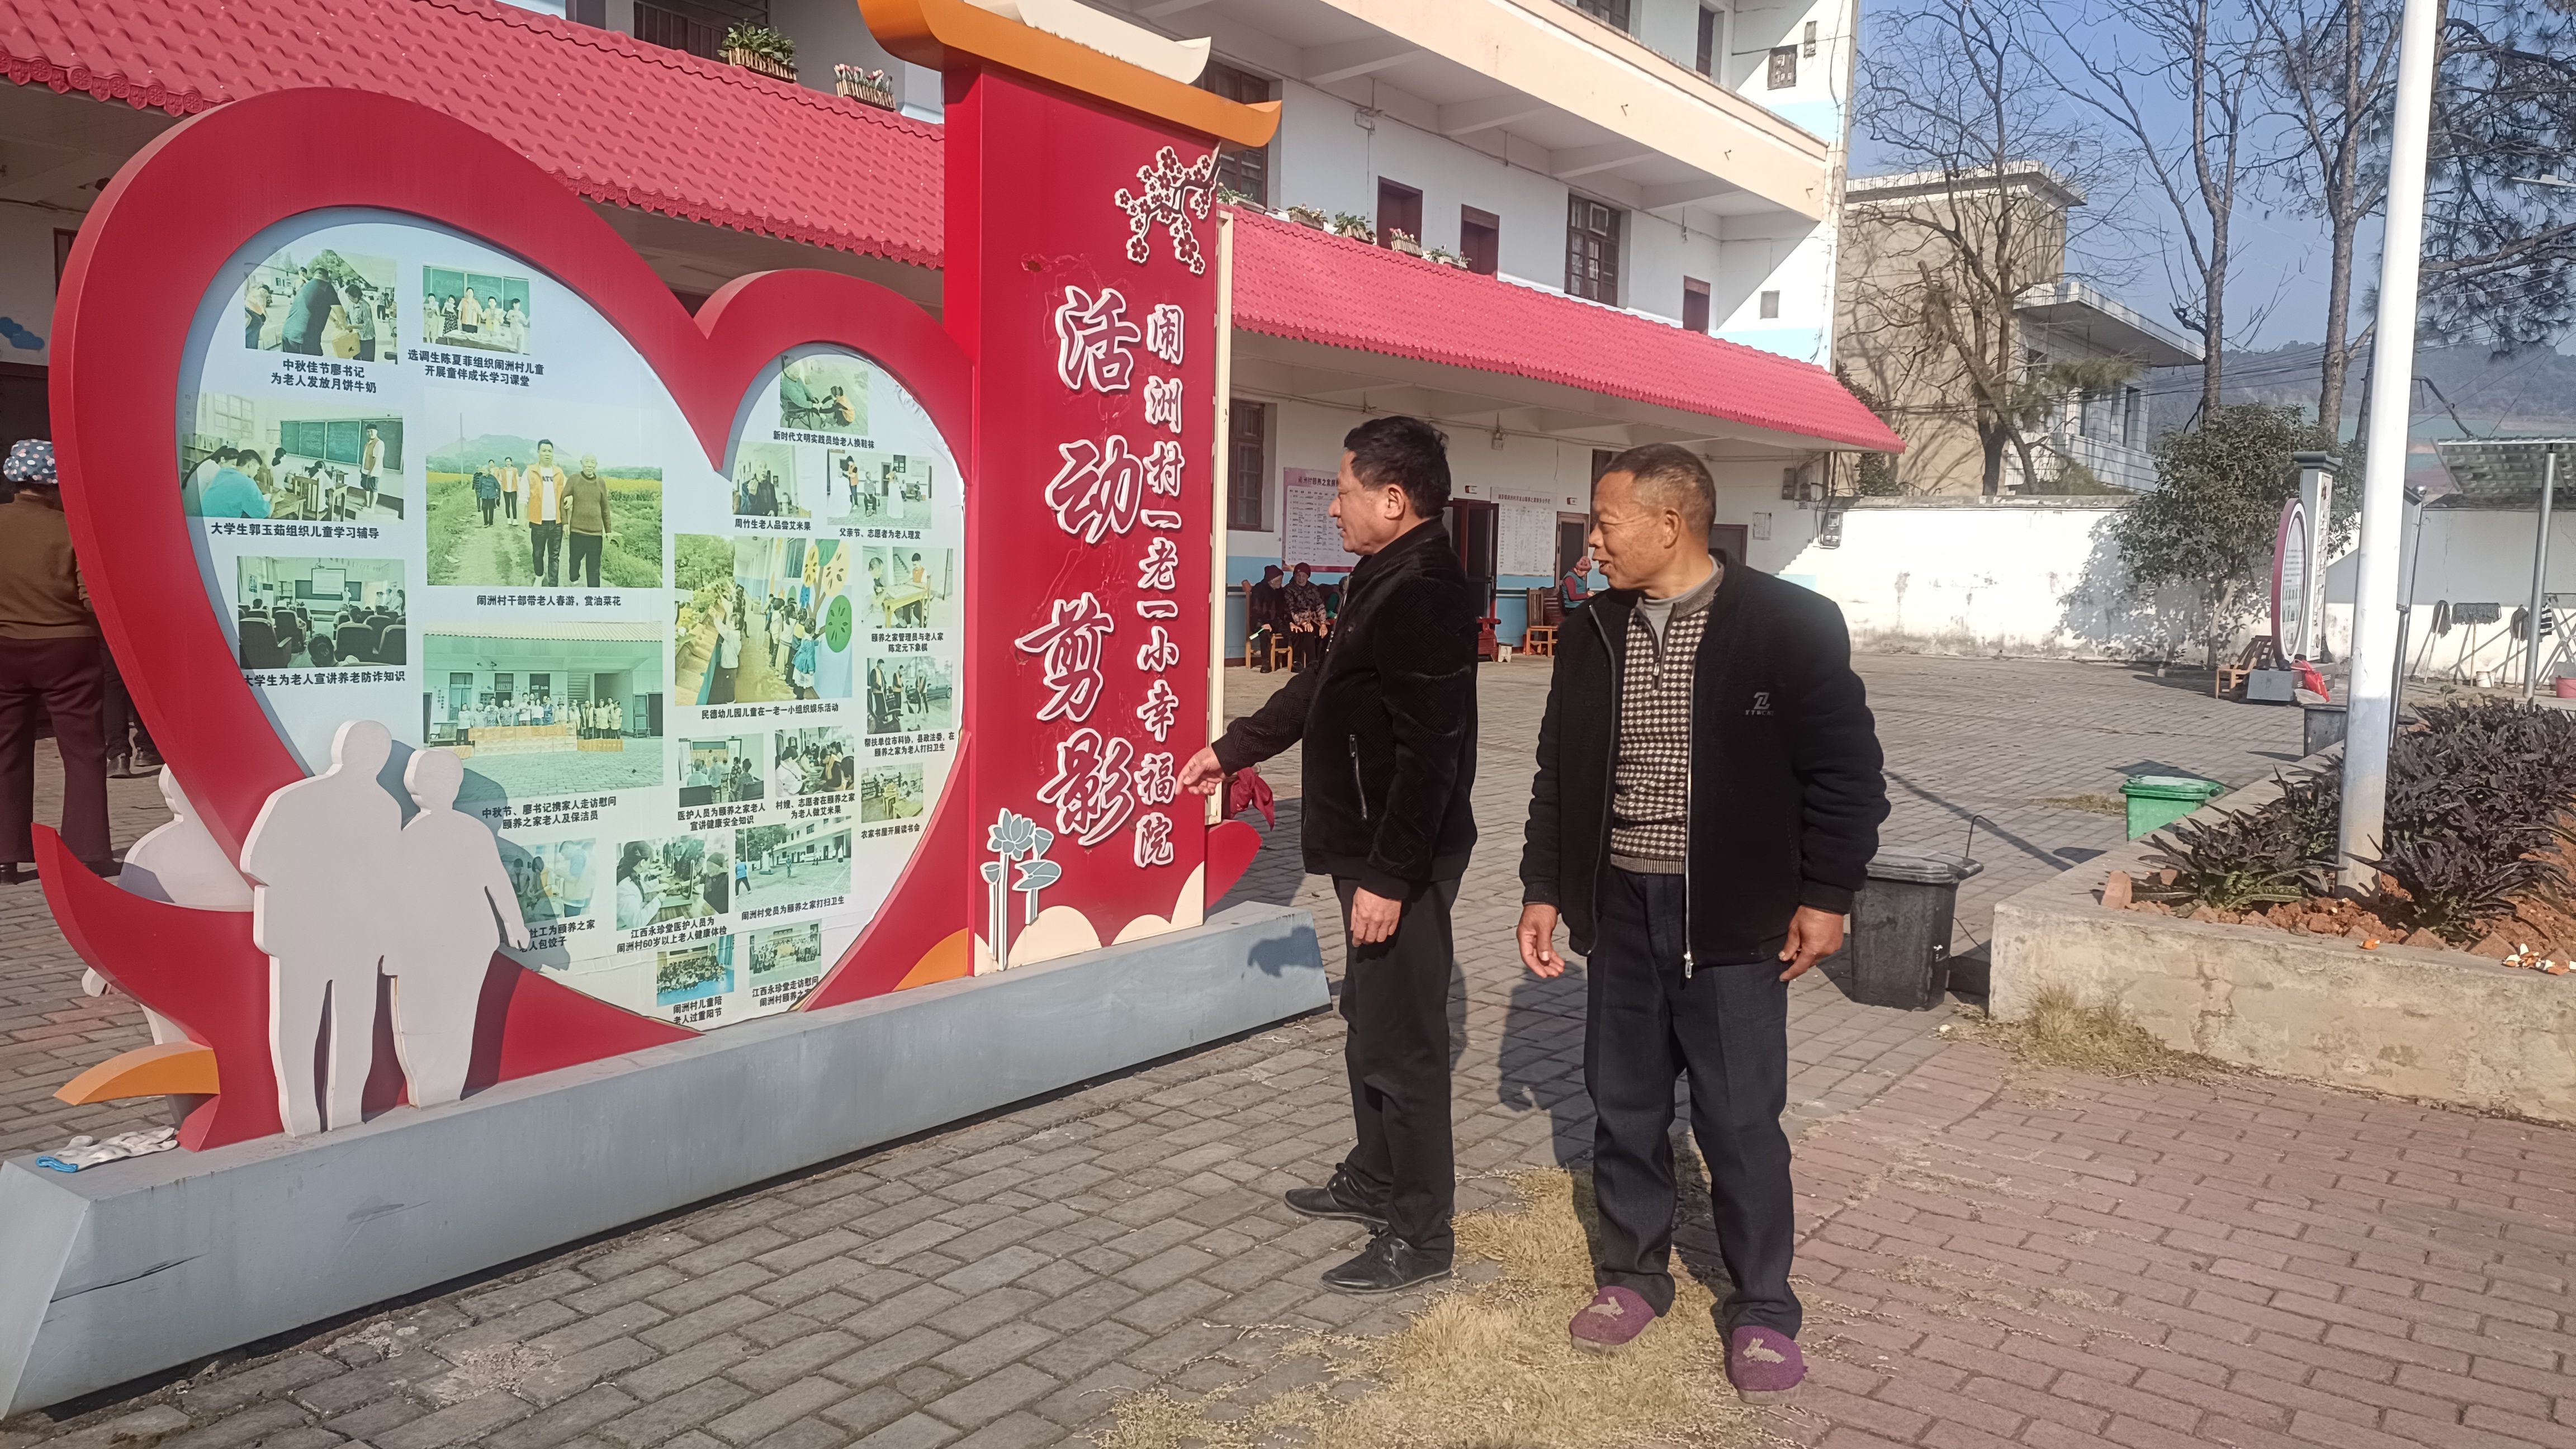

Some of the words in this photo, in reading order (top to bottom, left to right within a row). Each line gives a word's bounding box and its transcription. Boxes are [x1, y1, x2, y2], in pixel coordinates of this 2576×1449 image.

[282, 358, 365, 379] 中秋佳节廖书记
[408, 349, 544, 375] 选调生陈夏菲组织闹洲村儿童
[271, 372, 377, 394] 为老人发放月饼牛奶
[425, 364, 530, 387] 开展童伴成长学习课堂
[773, 430, 875, 449] 新时代文明实践员给老人换鞋袜
[211, 522, 380, 539] 大学生郭玉茹组织儿童学习辅导
[735, 518, 811, 532] 周竹生老人品尝艾米果
[839, 528, 921, 539] 父亲节、志愿者为老人理发
[1014, 285, 1143, 846] 活动剪影
[1133, 304, 1185, 868] 闹洲村一老一小幸福院
[476, 595, 621, 607] 闹洲村干部带老人春游，赏油菜花
[871, 632, 944, 643] 颐养之家管理员与老人家
[888, 642, 928, 653] 陈定元下象棋
[244, 670, 405, 687] 大学生为老人宣讲养老防诈知识
[701, 703, 839, 720] 民德幼儿园儿童在一老一小组织娱乐活动
[874, 742, 945, 757] 颐养之家为老人打扫卫生
[482, 795, 617, 819] 中秋节、廖书记携家人走访慰问
[775, 792, 855, 810] 村嫂、志愿者在颐养之家
[503, 811, 599, 830] 颐养之家老人及保洁员
[678, 802, 766, 821] 医护人员为颐养之家老人
[790, 804, 841, 820] 为老人做艾米果
[690, 815, 754, 831] 宣讲健康安全知识
[861, 823, 920, 839] 农家书屋开展读书会
[741, 896, 845, 921] 闹洲村党员为颐养之家打扫卫生
[631, 917, 714, 939] 江西永珍堂医护人员为
[617, 927, 727, 953] 闹洲村60岁以上老人健康体检
[752, 976, 818, 997] 江西永珍堂走访慰问
[673, 996, 722, 1015] 闹洲村儿童陪
[673, 1007, 722, 1025] 老人过重阳节
